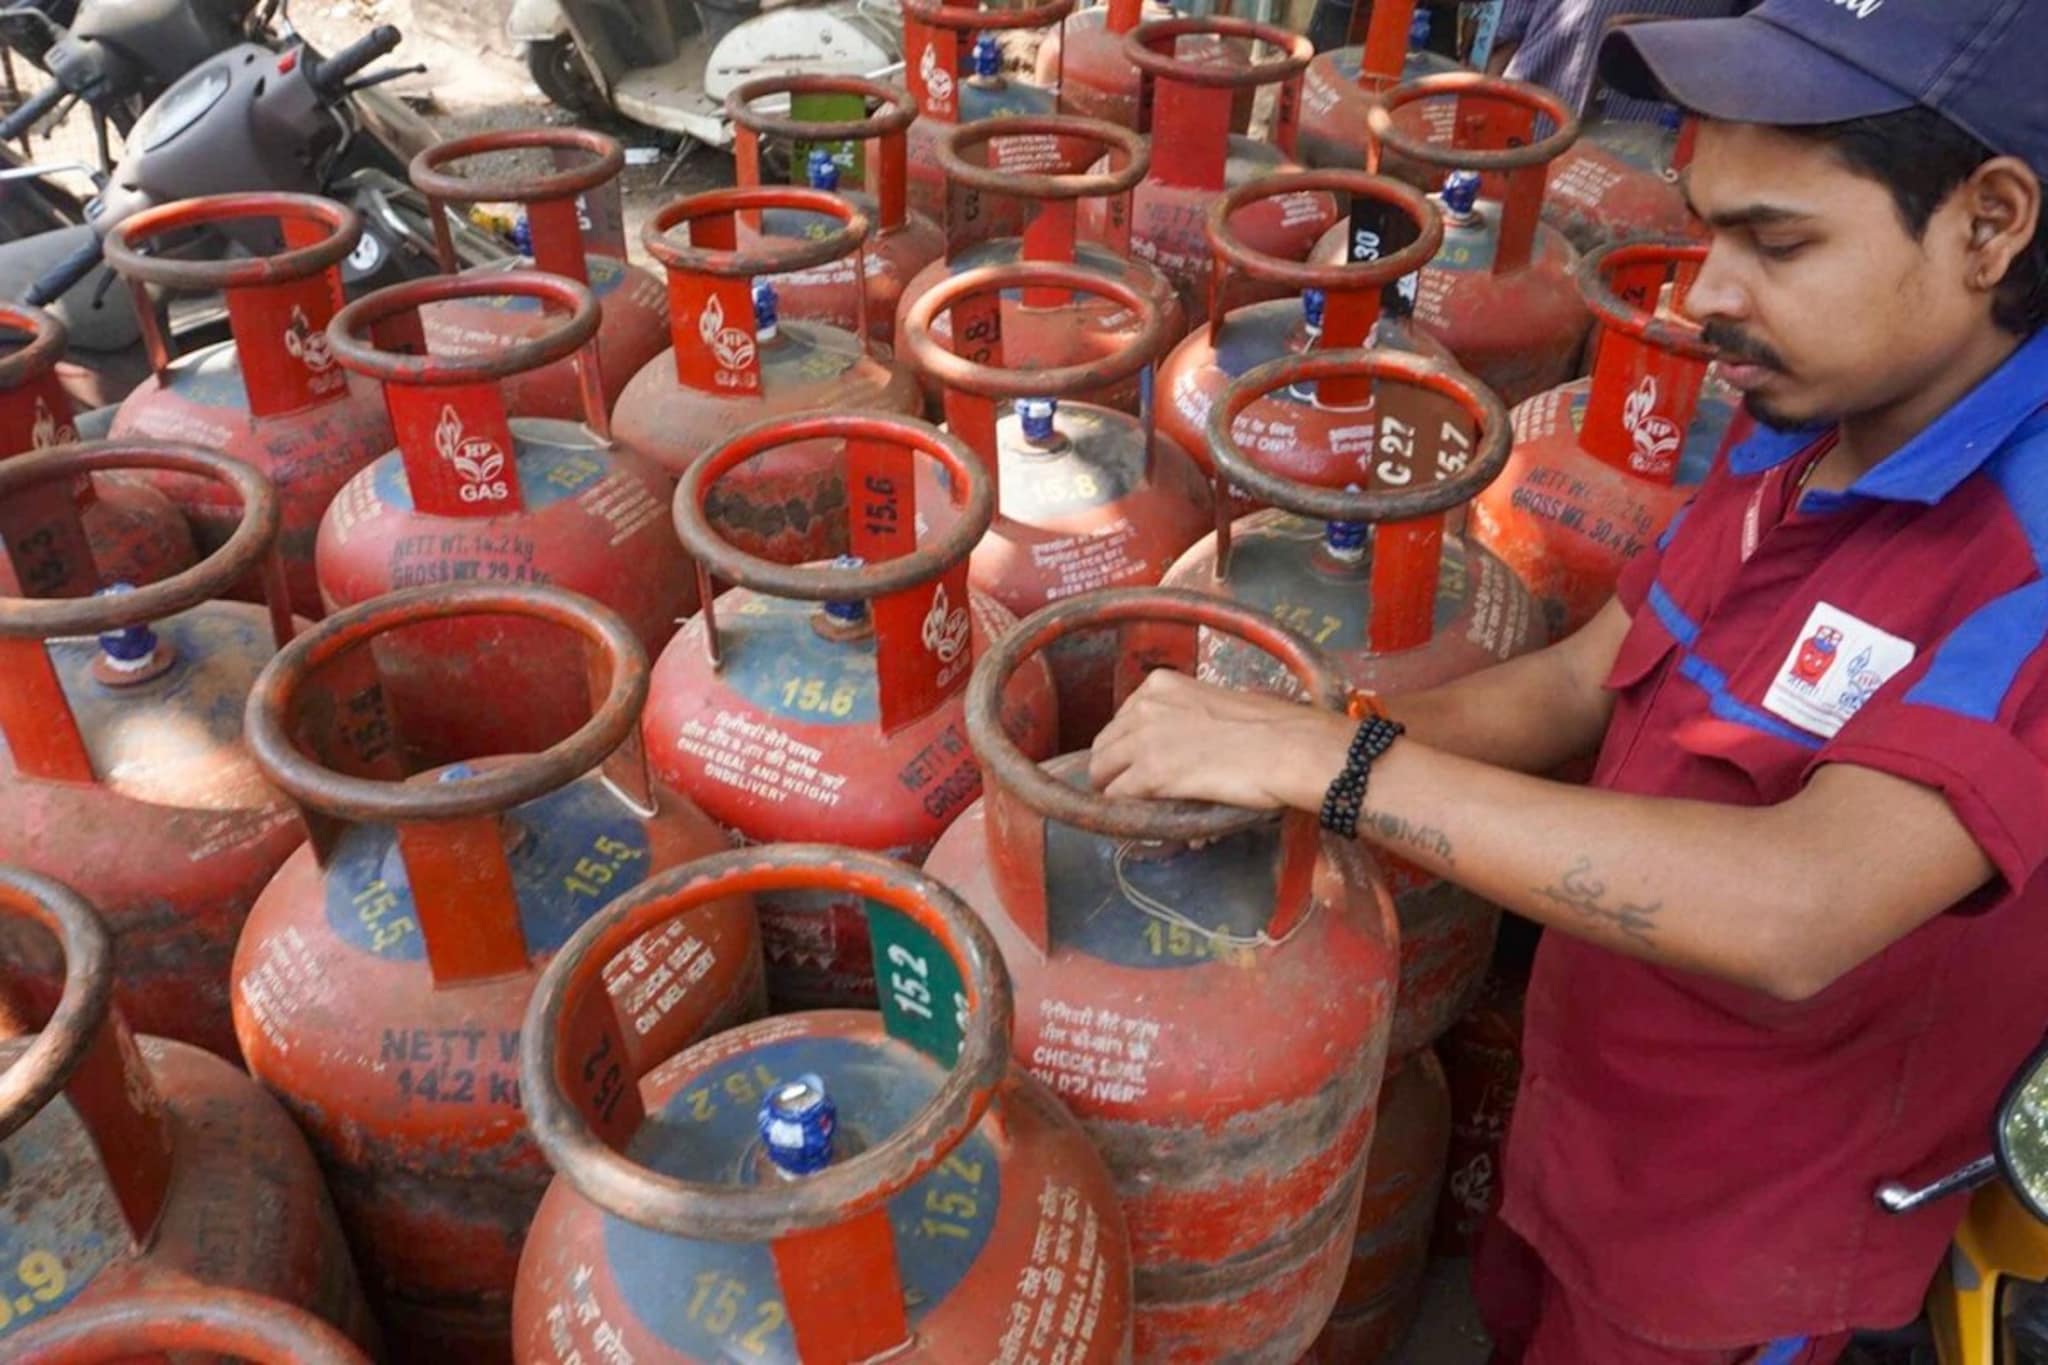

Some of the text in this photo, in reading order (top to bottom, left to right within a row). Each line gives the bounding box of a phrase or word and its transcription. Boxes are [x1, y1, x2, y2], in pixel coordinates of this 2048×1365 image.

[1435, 421, 1470, 481] 5.7
[459, 482, 509, 503] GAS
[782, 676, 858, 718] 15.6
[749, 762, 781, 785] AND
[780, 774, 842, 809] WEIGHT
[352, 879, 416, 953] 15.5
[381, 1026, 487, 1063] NETT
[396, 1066, 476, 1104] 14.2
